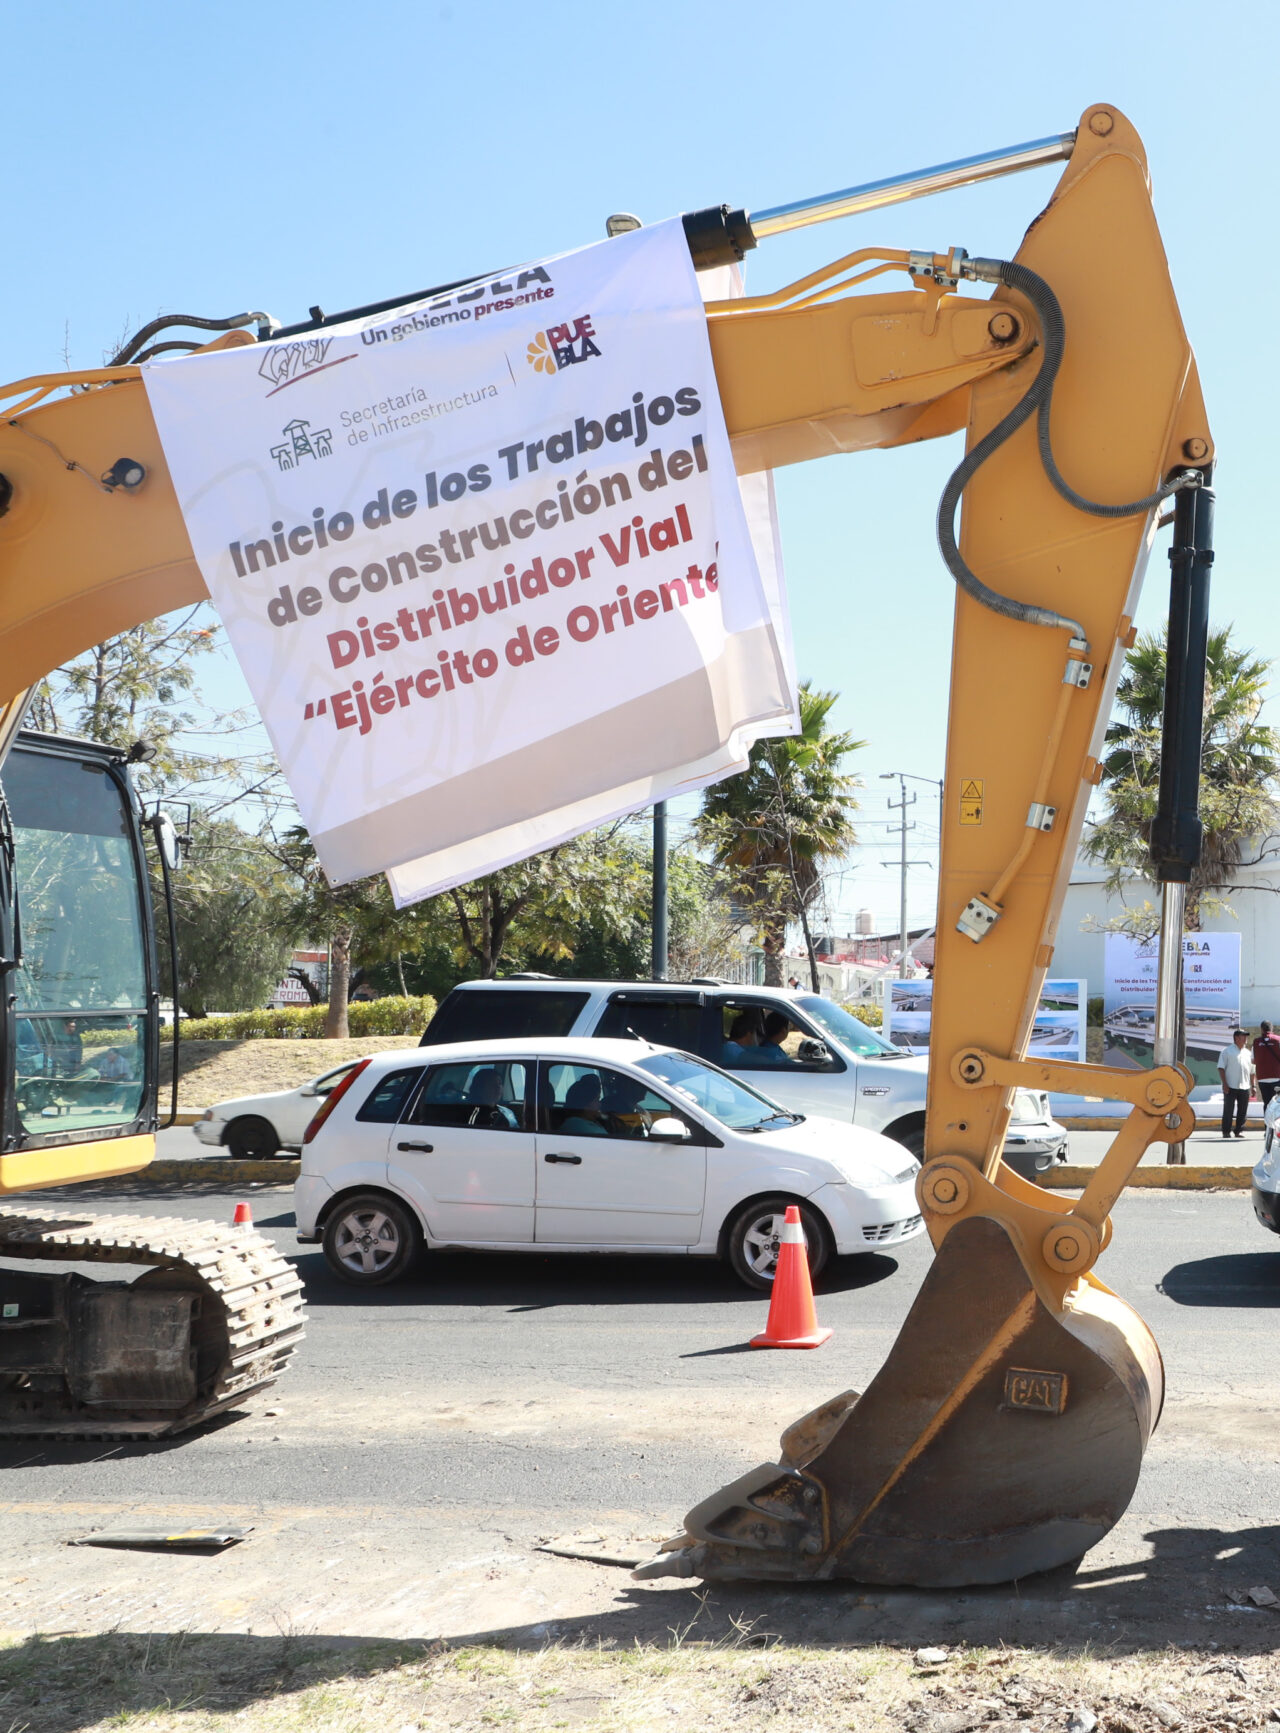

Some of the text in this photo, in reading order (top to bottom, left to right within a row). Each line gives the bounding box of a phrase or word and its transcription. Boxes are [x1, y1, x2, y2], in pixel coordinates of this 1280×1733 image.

[360, 286, 554, 346] Un gobierno presente
[547, 314, 597, 350] PUE
[340, 386, 428, 428] Secretaría
[347, 384, 499, 447] de Infraestructura
[229, 387, 702, 578] Inicio de los Trabajos
[267, 433, 709, 627] de Construcción del
[326, 503, 694, 670] Distribuidor Vial
[504, 625, 560, 668] de
